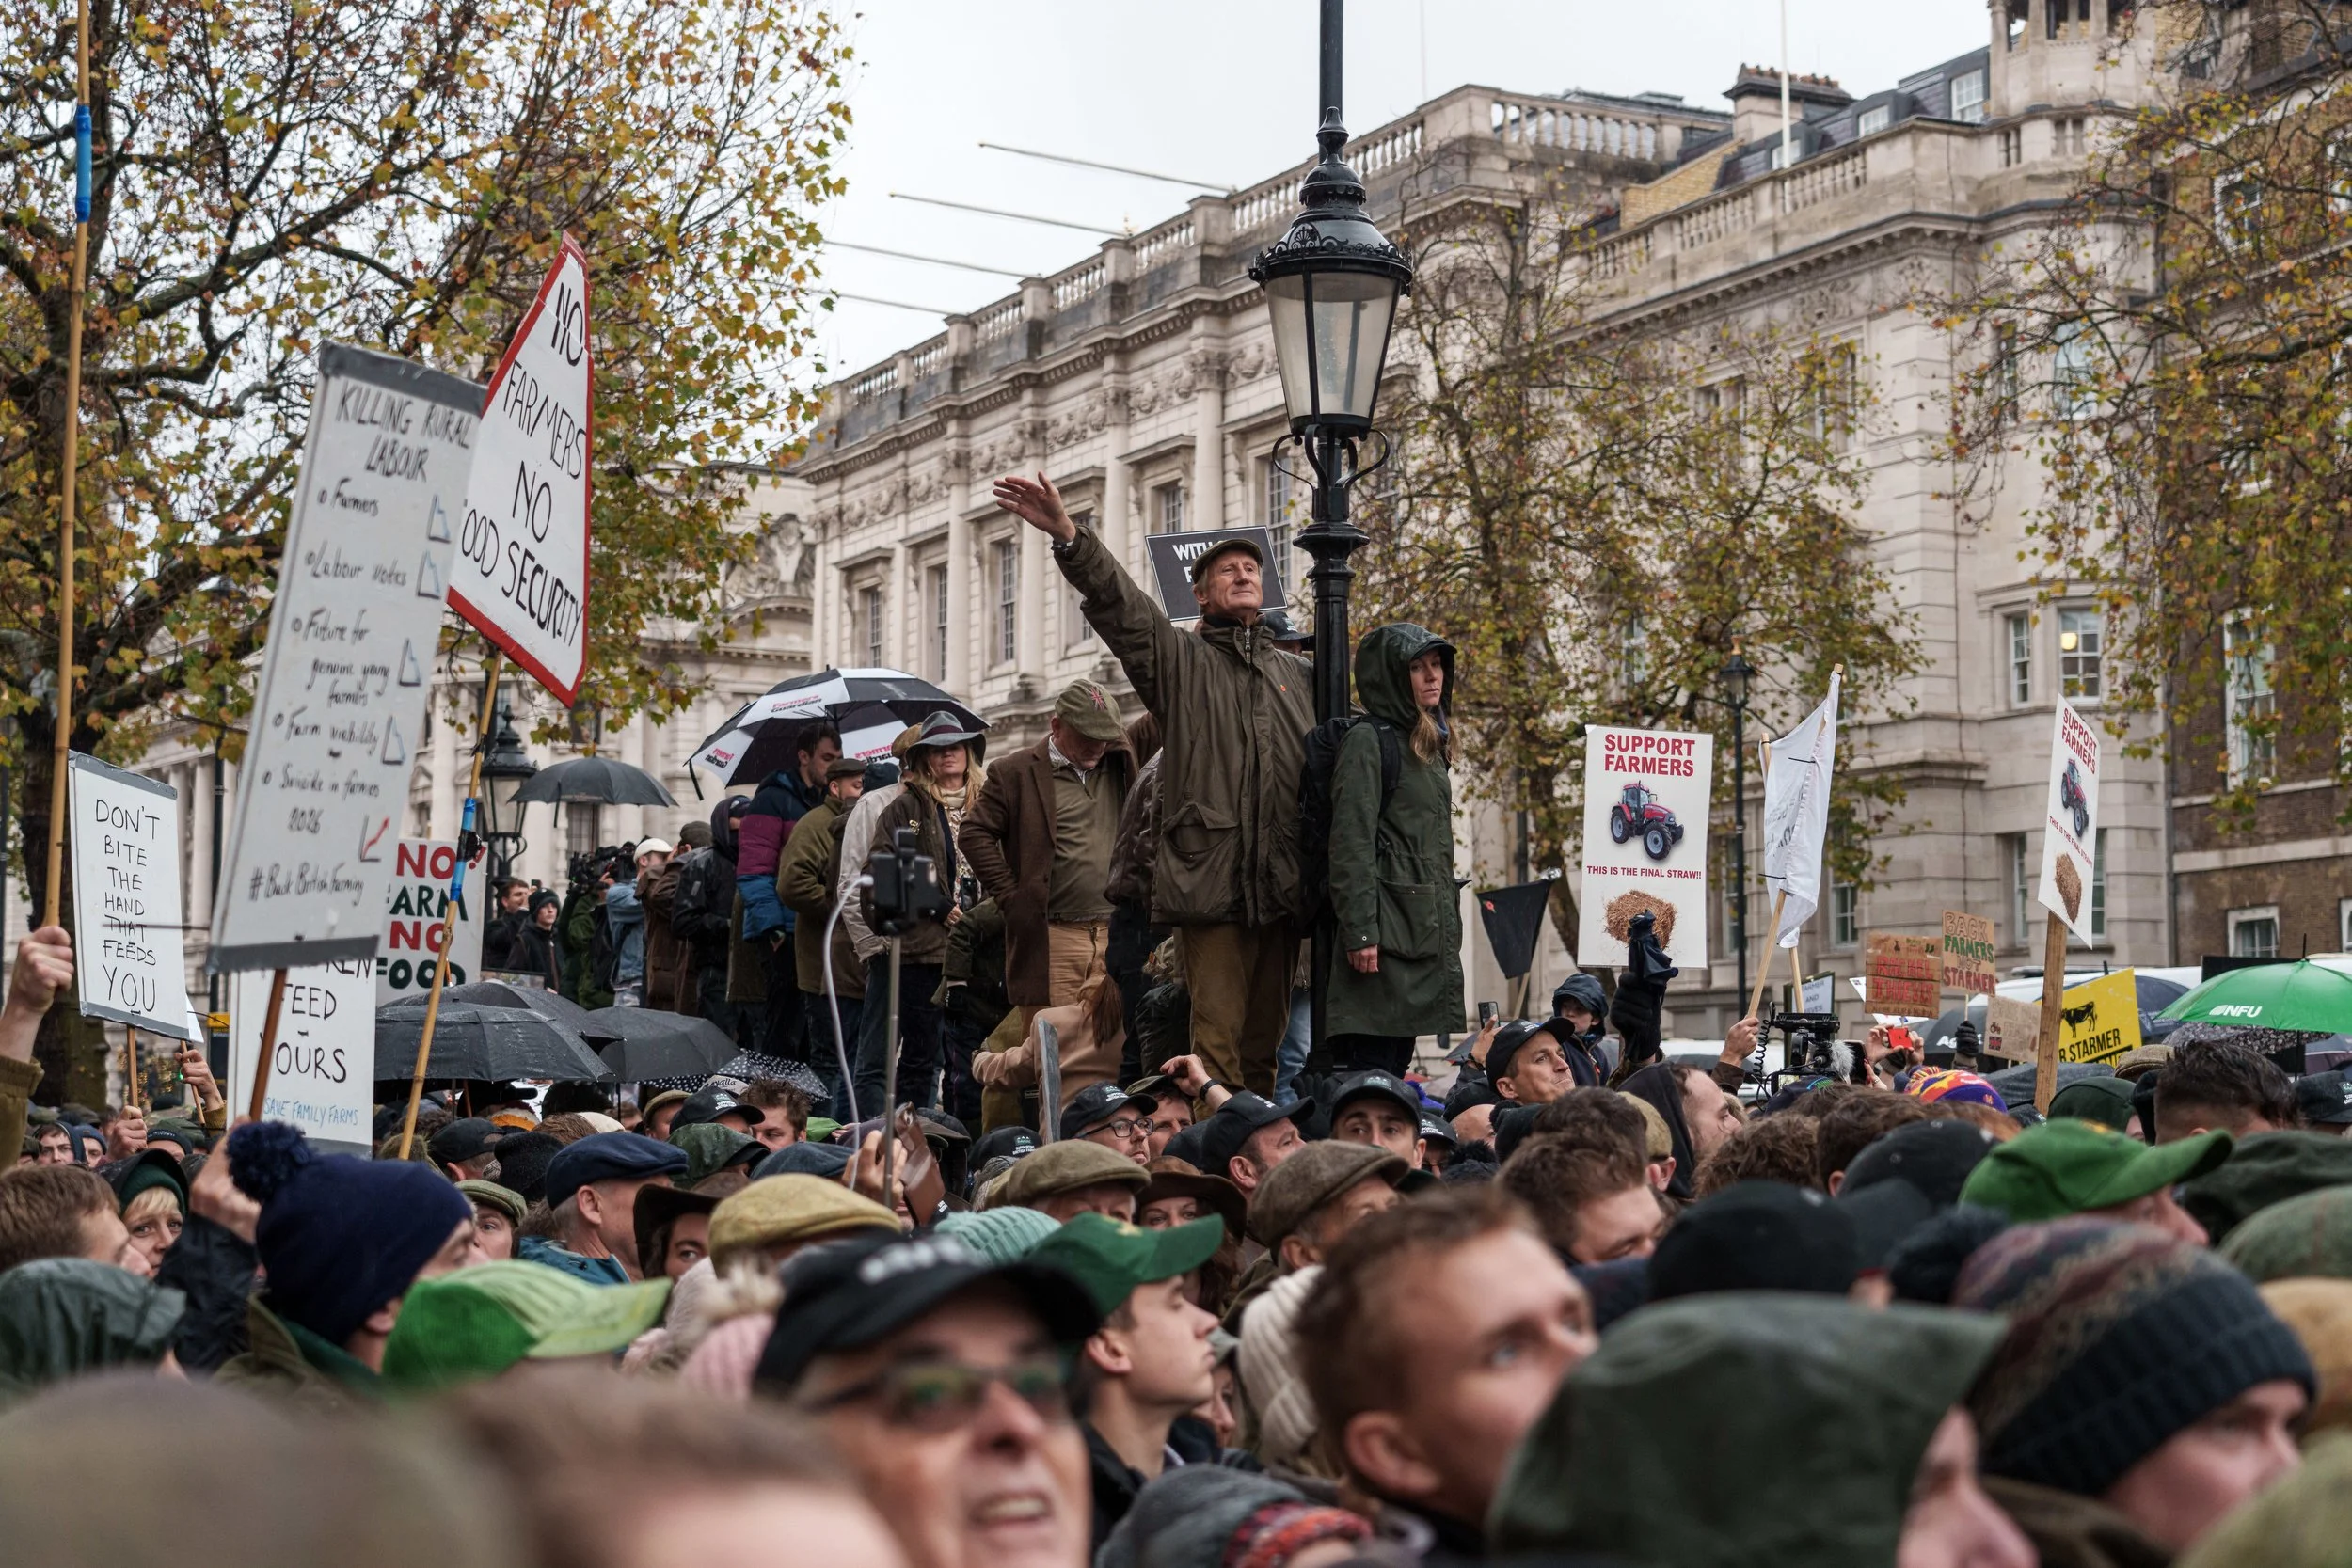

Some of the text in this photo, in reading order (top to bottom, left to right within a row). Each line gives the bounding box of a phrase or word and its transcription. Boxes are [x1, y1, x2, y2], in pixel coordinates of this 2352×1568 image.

[550, 282, 583, 367] NO
[336, 379, 472, 450] KILLING RURAL
[503, 359, 587, 480] FARMERS
[365, 435, 429, 483] LABOUR
[332, 476, 379, 516] Farmers
[512, 460, 551, 543] NO
[311, 541, 407, 587] Labour votes
[462, 499, 583, 647] OOD SECURITY
[303, 607, 370, 645] Future for
[327, 679, 368, 707] farmers
[358, 664, 390, 696] young
[285, 706, 379, 756] Farm viability
[1605, 734, 1695, 756] SUPPORT
[2063, 707, 2097, 752] SUPPORT
[1605, 754, 1694, 777] FARMERS
[2061, 725, 2095, 775] FARMERS
[279, 763, 324, 792] Suicide
[329, 772, 339, 793] in
[96, 799, 160, 840] DON'T
[288, 807, 324, 834] 2026
[104, 835, 147, 866] BITE
[107, 866, 142, 892] THE
[1587, 866, 1702, 879] THIS IS THE FINAL STRAW!!
[104, 892, 144, 915] HAND
[387, 884, 469, 921] ARM
[104, 914, 147, 942] THAT
[389, 921, 453, 954] NO
[1944, 911, 1988, 942] BACK
[103, 940, 156, 965] FEEDS
[1944, 935, 1994, 963] FARMERS
[1958, 956, 1981, 972] NOT
[1876, 956, 1934, 980] RACHEL
[1943, 966, 1995, 995] STARMER
[102, 962, 156, 1012] YOU
[2223, 1005, 2262, 1018] NFU
[260, 1032, 347, 1083] OURS
[2069, 1028, 2121, 1062] STARMER
[263, 1097, 358, 1127] SAVE FAMILY FARMS
